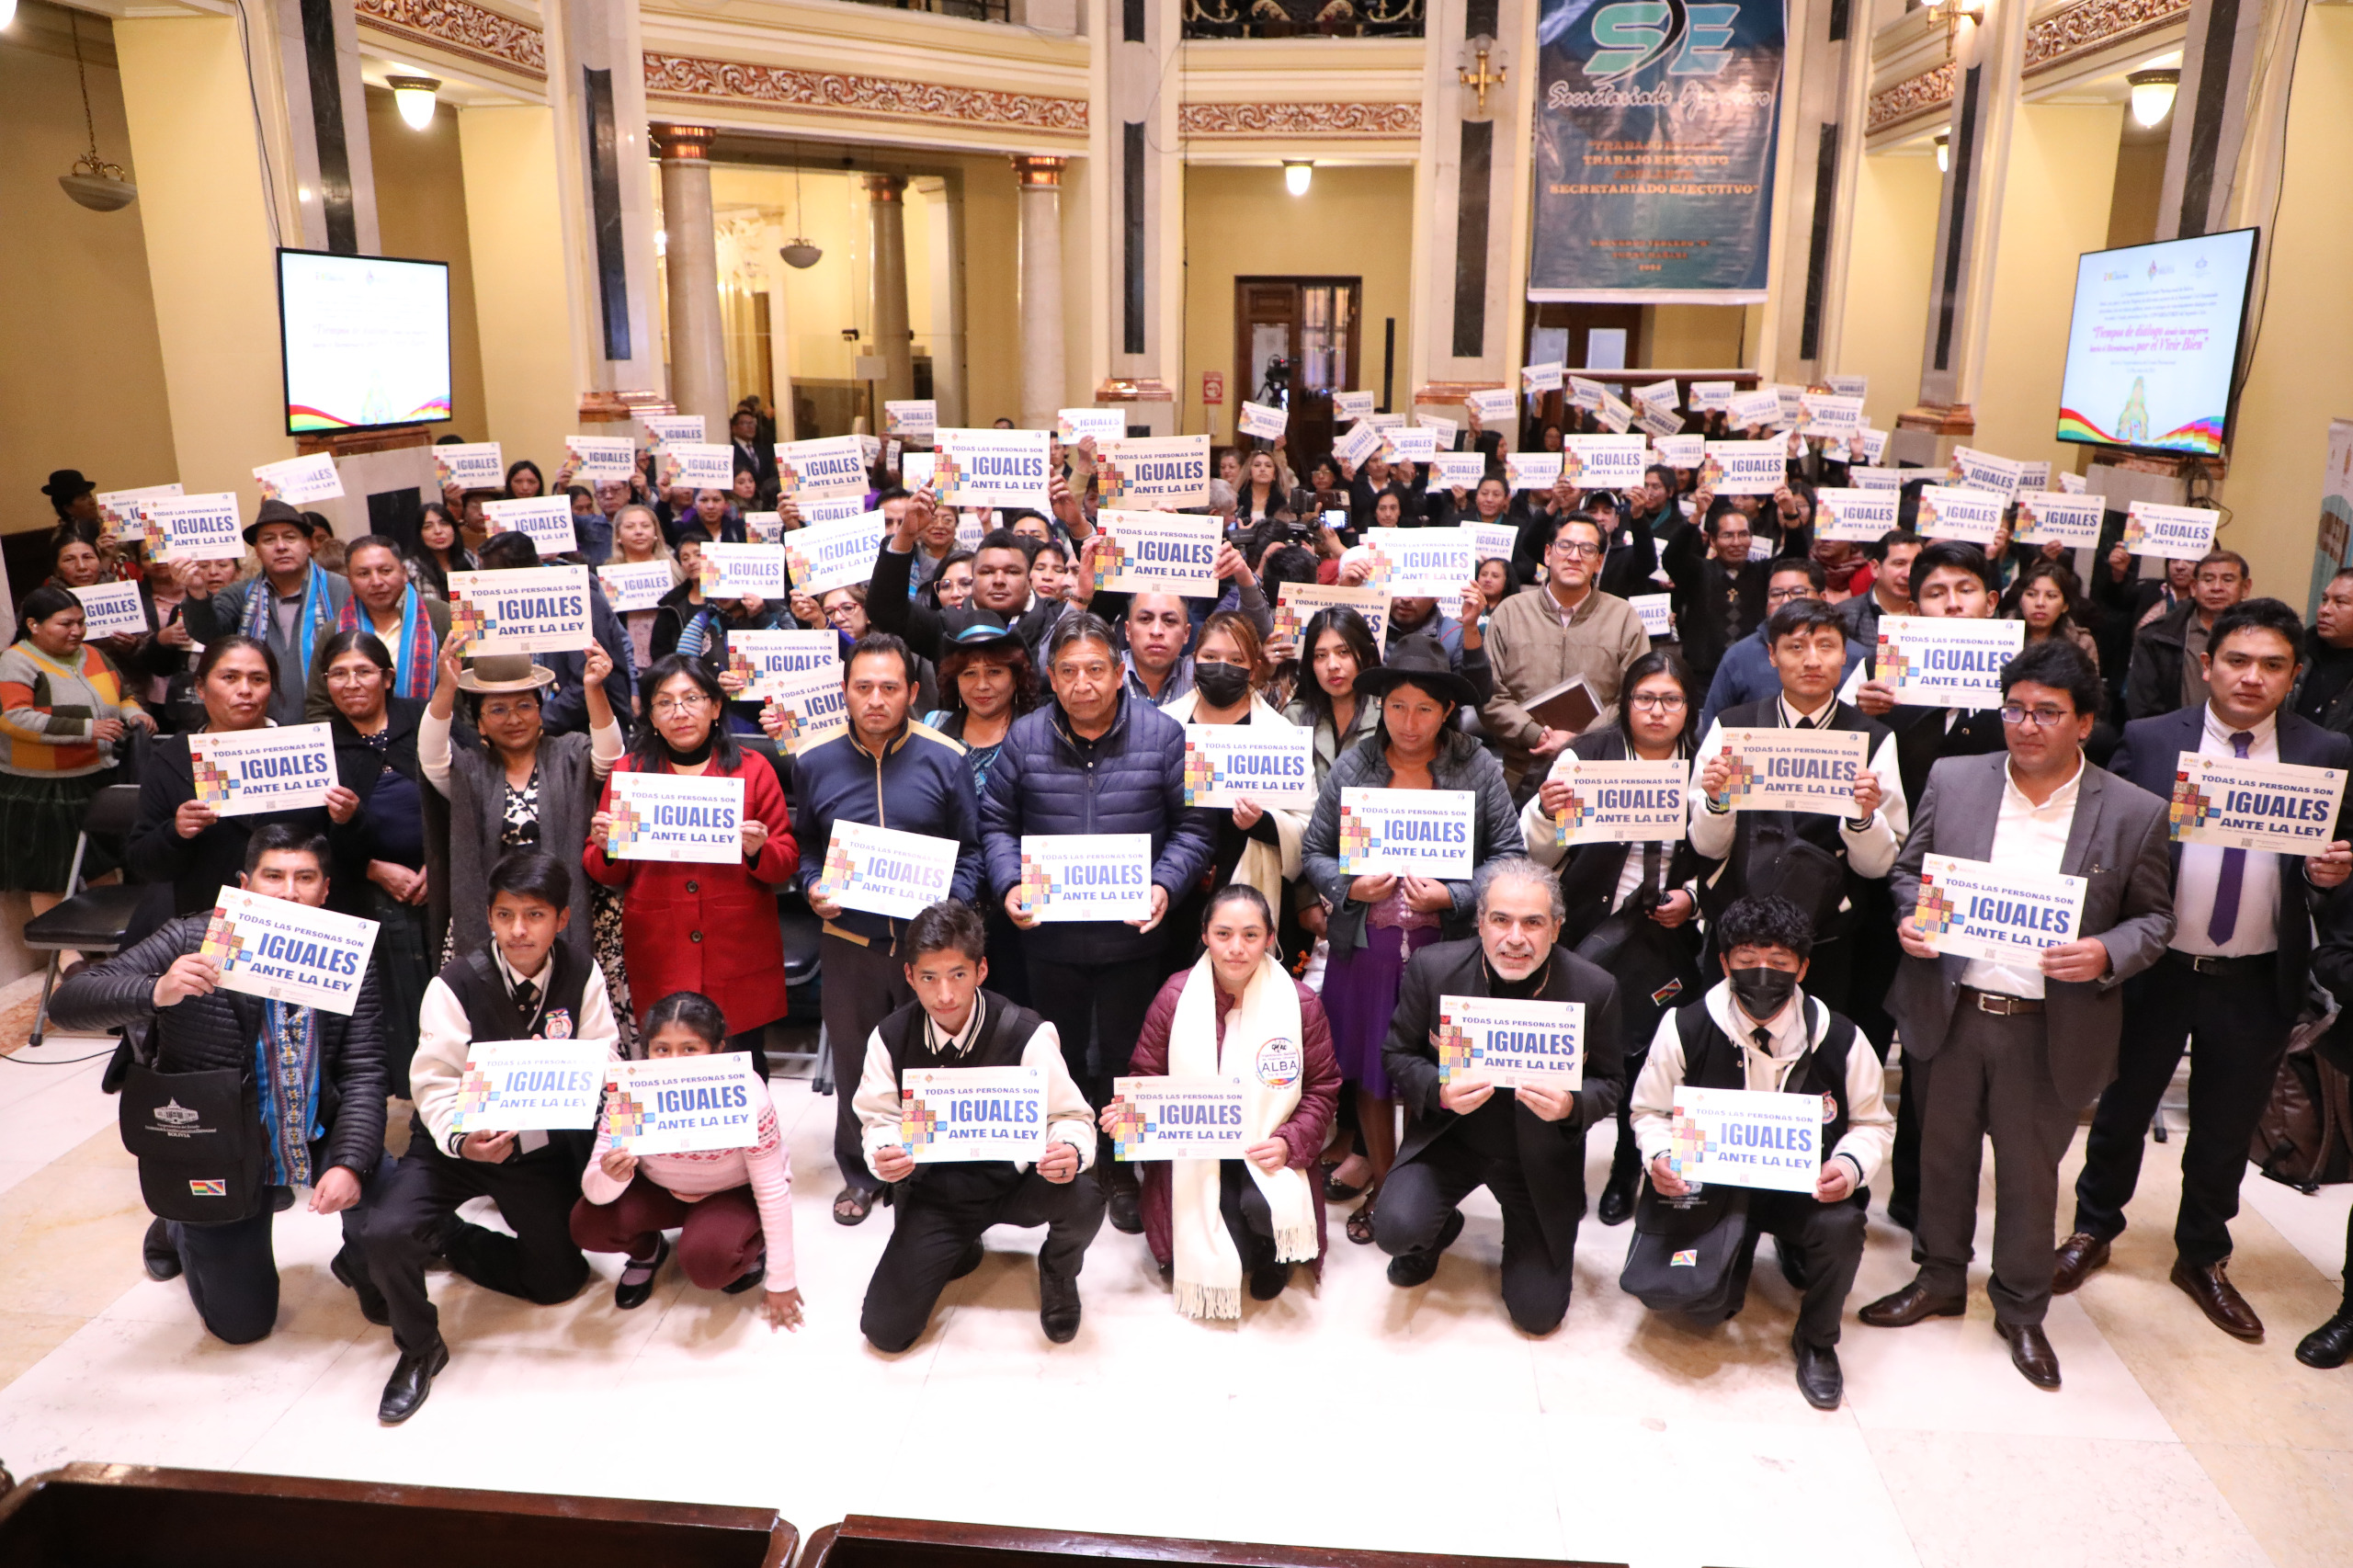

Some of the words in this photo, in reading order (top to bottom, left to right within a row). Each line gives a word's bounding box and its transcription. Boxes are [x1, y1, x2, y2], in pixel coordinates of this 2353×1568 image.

[1583, 155, 1653, 165] TRABAJO
[1654, 155, 1729, 165] EFECTIVO
[1613, 170, 1695, 180] ADELANTE
[1549, 184, 1668, 195] SECRETARIADO
[1347, 400, 1371, 409] IGUALES
[1485, 398, 1514, 408] IGUALES
[903, 411, 933, 420] IGUALES
[1079, 415, 1120, 427] IGUALES
[1819, 410, 1857, 422] IGUALES
[665, 429, 702, 439] IGUALES
[1401, 438, 1432, 449] IGUALES
[589, 450, 631, 462] IGUALES
[1591, 452, 1640, 466] IGUALES
[688, 460, 730, 472] IGUALES
[805, 457, 859, 476] IGUALES
[972, 456, 1042, 476] IGUALES
[1135, 460, 1203, 481] IGUALES
[1448, 465, 1481, 474] IGUALES
[1524, 463, 1558, 474] IGUALES
[1732, 459, 1780, 472] IGUALES
[1970, 467, 2015, 489] IGUALES
[1843, 506, 1893, 520] IGUALES
[1945, 506, 1996, 522] IGUALES
[2044, 510, 2097, 527] IGUALES
[172, 515, 234, 534] IGUALES
[515, 515, 567, 532] IGUALES
[2154, 522, 2210, 540] IGUALES
[818, 533, 879, 562] IGUALES
[1137, 540, 1212, 563] IGUALES
[1403, 551, 1468, 568] IGUALES
[729, 562, 779, 575] IGUALES
[1134, 565, 1167, 575] ANTE
[1171, 568, 1186, 576] LA
[1190, 569, 1212, 577] LEY
[623, 575, 668, 591] IGUALES
[497, 596, 583, 620] IGUALES
[498, 625, 535, 635] ANTE
[539, 623, 556, 632] LA
[561, 621, 584, 631] LEY
[213, 749, 243, 757] TODAS
[263, 744, 305, 752] PERSONAS
[240, 753, 327, 779] IGUALES
[1226, 754, 1303, 776] IGUALES
[1768, 757, 1857, 780] IGUALES
[243, 783, 279, 794] ANTE
[284, 781, 301, 790] LA
[305, 778, 330, 788] LEY
[2201, 775, 2234, 784] TODAS
[2259, 782, 2310, 792] PERSONAS
[1597, 789, 1678, 809] IGUALES
[2225, 790, 2328, 822] IGUALES
[654, 804, 734, 828] IGUALES
[1383, 819, 1465, 843] IGUALES
[2220, 817, 2264, 830] ANTE
[2268, 823, 2289, 833] LA
[2294, 825, 2325, 836] LEY
[651, 831, 686, 841] ANTE
[690, 833, 707, 842] LA
[710, 834, 734, 843] LEY
[1381, 846, 1416, 856] ANTE
[1421, 847, 1438, 857] LA
[1441, 848, 1465, 858] LEY
[866, 856, 944, 888] IGUALES
[1063, 864, 1142, 885] IGUALES
[1969, 895, 2070, 933] IGUALES
[238, 913, 271, 926] TODAS
[274, 922, 290, 930] LAS
[294, 926, 342, 942] PERSONAS
[346, 938, 364, 947] SON
[257, 932, 358, 974] IGUALES
[250, 962, 294, 979] ANTE
[298, 972, 317, 984] LA
[323, 977, 352, 991] LEY
[1486, 1029, 1574, 1055] IGUALES
[1261, 1060, 1298, 1073] ALBA
[1484, 1057, 1521, 1067] ANTE
[1527, 1060, 1544, 1069] LA
[1549, 1061, 1574, 1070] LEY
[505, 1069, 593, 1092] IGUALES
[681, 1074, 725, 1083] PERSONAS
[656, 1085, 746, 1113] IGUALES
[950, 1099, 1038, 1122] IGUALES
[1159, 1104, 1241, 1124] IGUALES
[657, 1118, 696, 1130] ANTE
[700, 1116, 719, 1126] LA
[723, 1113, 748, 1124] LEY
[949, 1129, 986, 1138] ANTE
[991, 1129, 1008, 1138] LA
[1013, 1129, 1038, 1138] LEY
[1157, 1131, 1192, 1139] ANTE
[1198, 1131, 1214, 1139] LA
[1218, 1131, 1242, 1139] LEY
[1721, 1122, 1812, 1152] IGUALES
